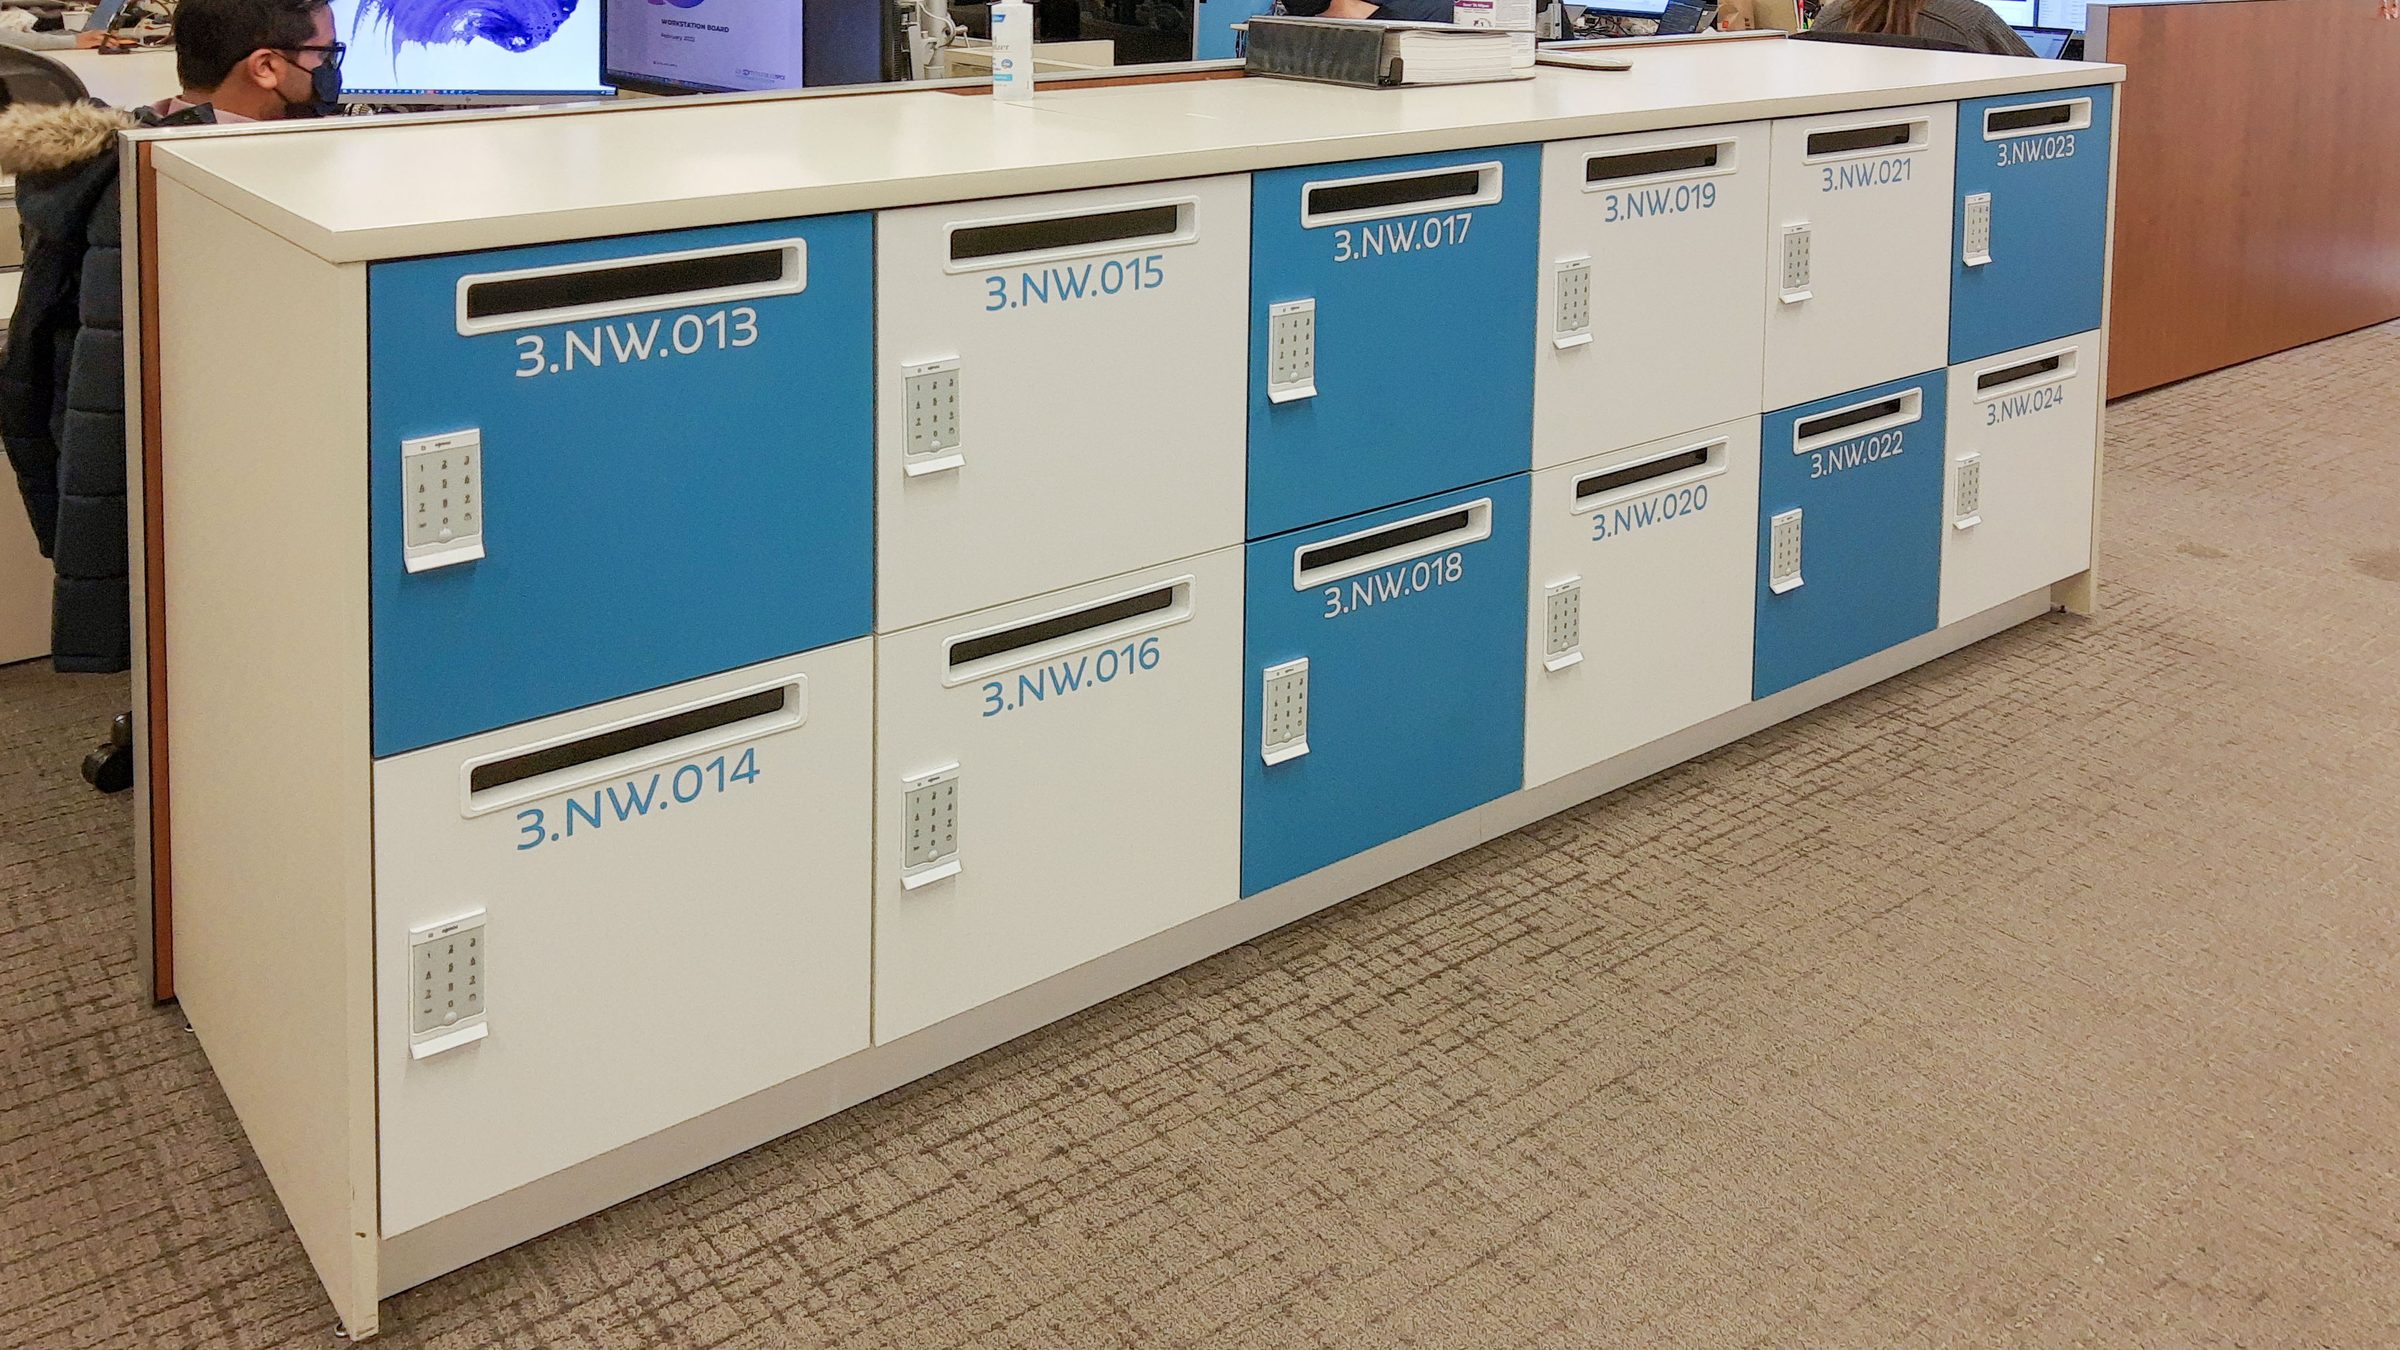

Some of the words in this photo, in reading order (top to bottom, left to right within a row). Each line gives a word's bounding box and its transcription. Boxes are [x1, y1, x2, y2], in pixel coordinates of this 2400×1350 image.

[661, 19, 706, 30] WORKSTATION
[707, 24, 730, 33] BOARD
[1822, 158, 1911, 192] 3.NW.021
[1997, 134, 2075, 167] 3.NW.023
[1605, 182, 1716, 222] 3.NW.019
[1334, 210, 1472, 263] 3.NW.017
[986, 255, 1165, 312] 3.NW.015
[515, 306, 759, 378] 3.NW.013
[1987, 384, 2063, 426] 3.NW.024
[1811, 431, 1903, 479] 3.NW.022
[1592, 485, 1707, 541] 3.NW.020
[1323, 550, 1465, 620] 3.NW.018
[983, 636, 1161, 718] 3.NW.016
[518, 747, 759, 850] 3.NW.014
